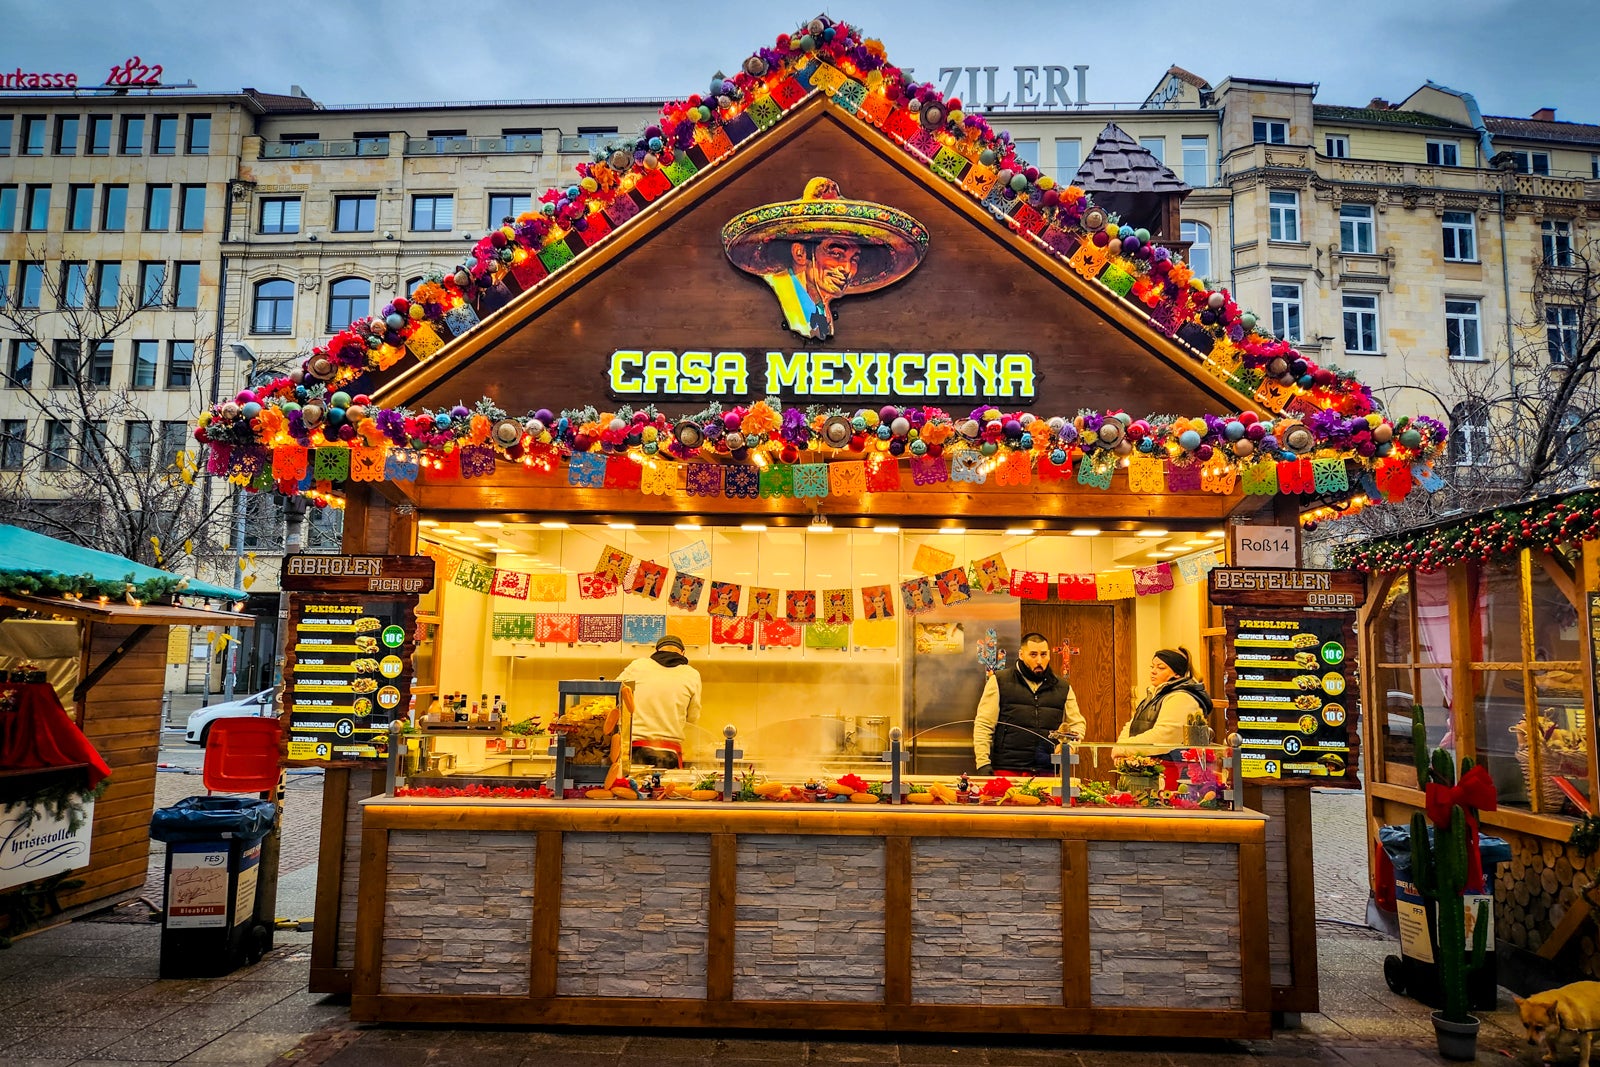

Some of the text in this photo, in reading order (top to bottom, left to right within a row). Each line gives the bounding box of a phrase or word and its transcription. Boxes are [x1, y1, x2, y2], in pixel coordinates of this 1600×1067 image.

[0, 55, 163, 87] rkasse 1822
[938, 65, 1089, 108] ZILERI
[608, 350, 1037, 397] CASA MEXICANA
[1241, 538, 1290, 552] Roß14
[288, 556, 383, 576] ABHOLEN
[368, 578, 424, 593] PICK UP
[1214, 570, 1332, 591] BESTELLEN
[1307, 592, 1355, 607] ORDER
[304, 604, 364, 614] PREISLISTE
[1239, 619, 1300, 630] PREISLISTE
[385, 633, 395, 643] 10
[1324, 649, 1334, 659] 10
[383, 664, 392, 673] 10
[1325, 681, 1335, 690] 10
[380, 694, 390, 704] 10
[1325, 711, 1335, 722] 10
[204, 855, 221, 863] FES
